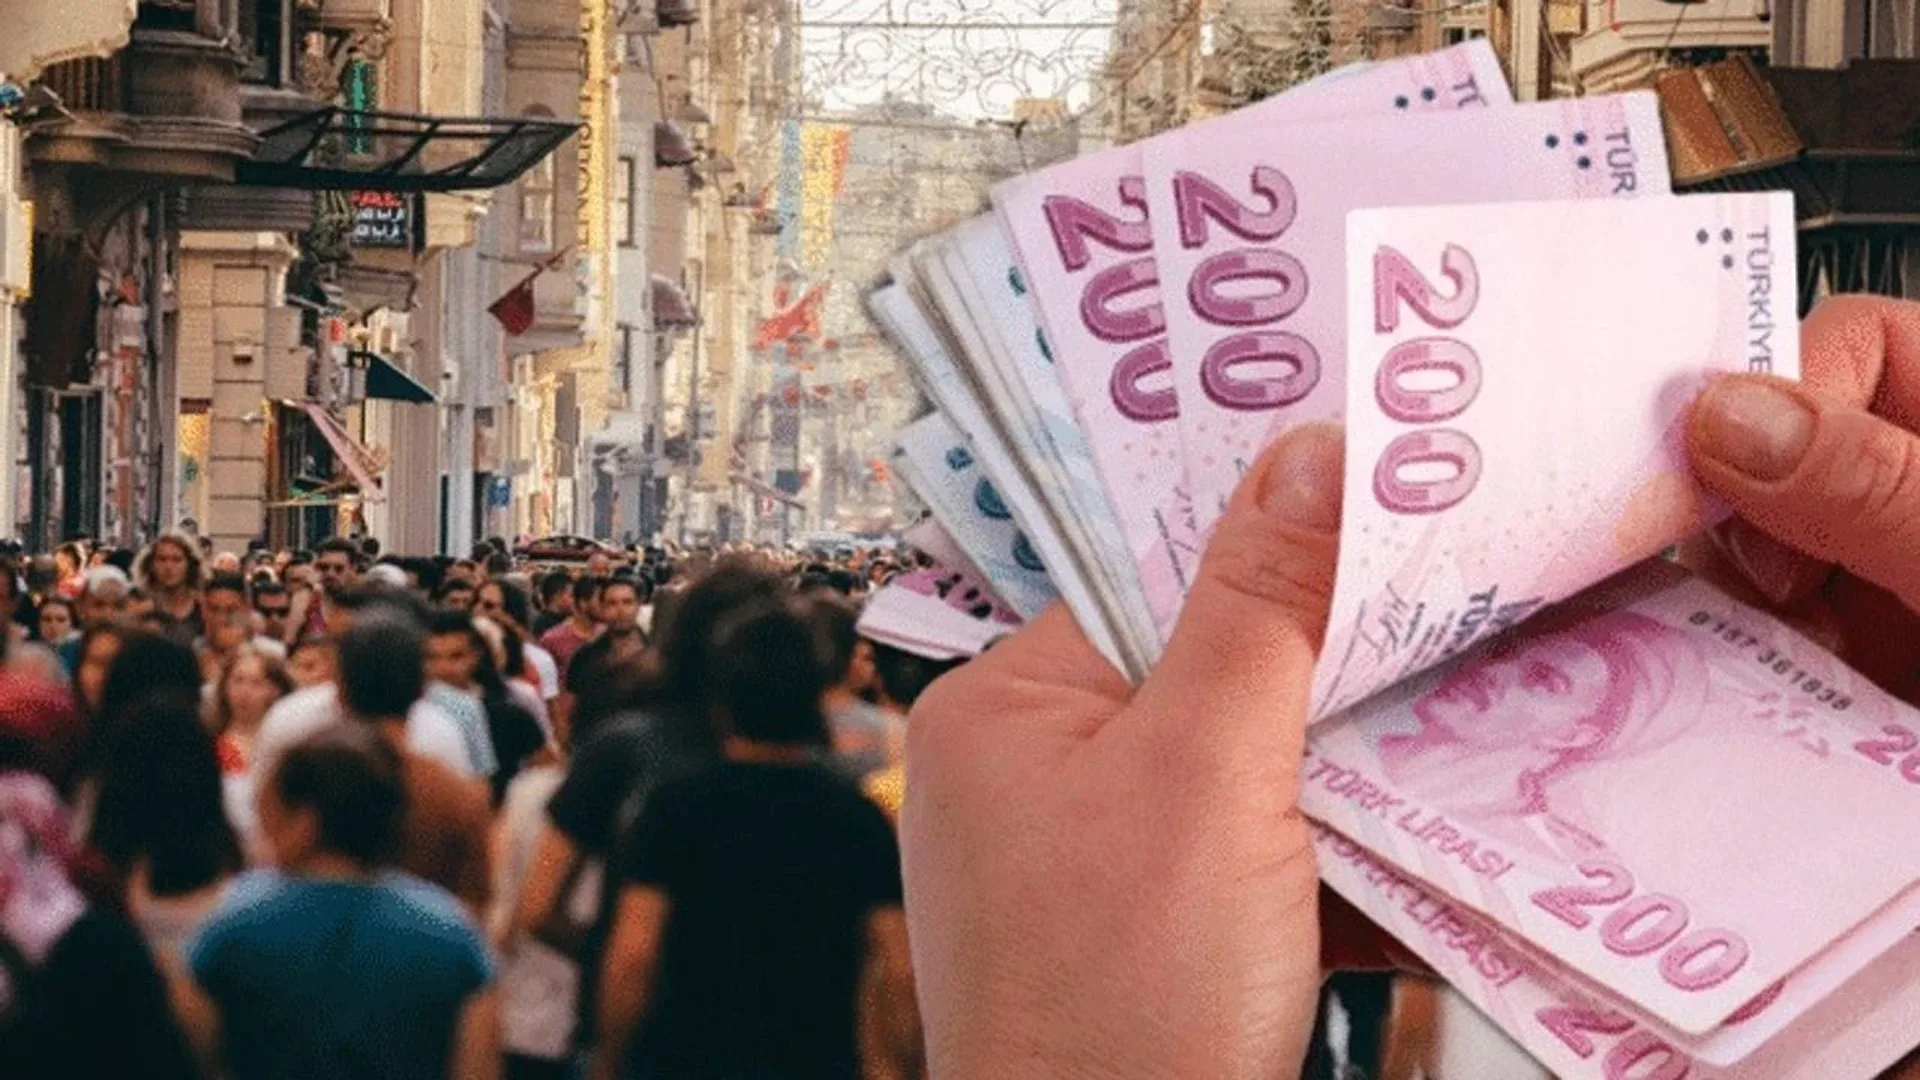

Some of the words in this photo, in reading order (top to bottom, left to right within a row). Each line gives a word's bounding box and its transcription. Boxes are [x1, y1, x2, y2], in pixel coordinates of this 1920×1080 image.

[1043, 175, 1179, 422] 200
[1173, 166, 1321, 411] 200
[1372, 242, 1483, 515] 200
[1530, 860, 1749, 992] 200
